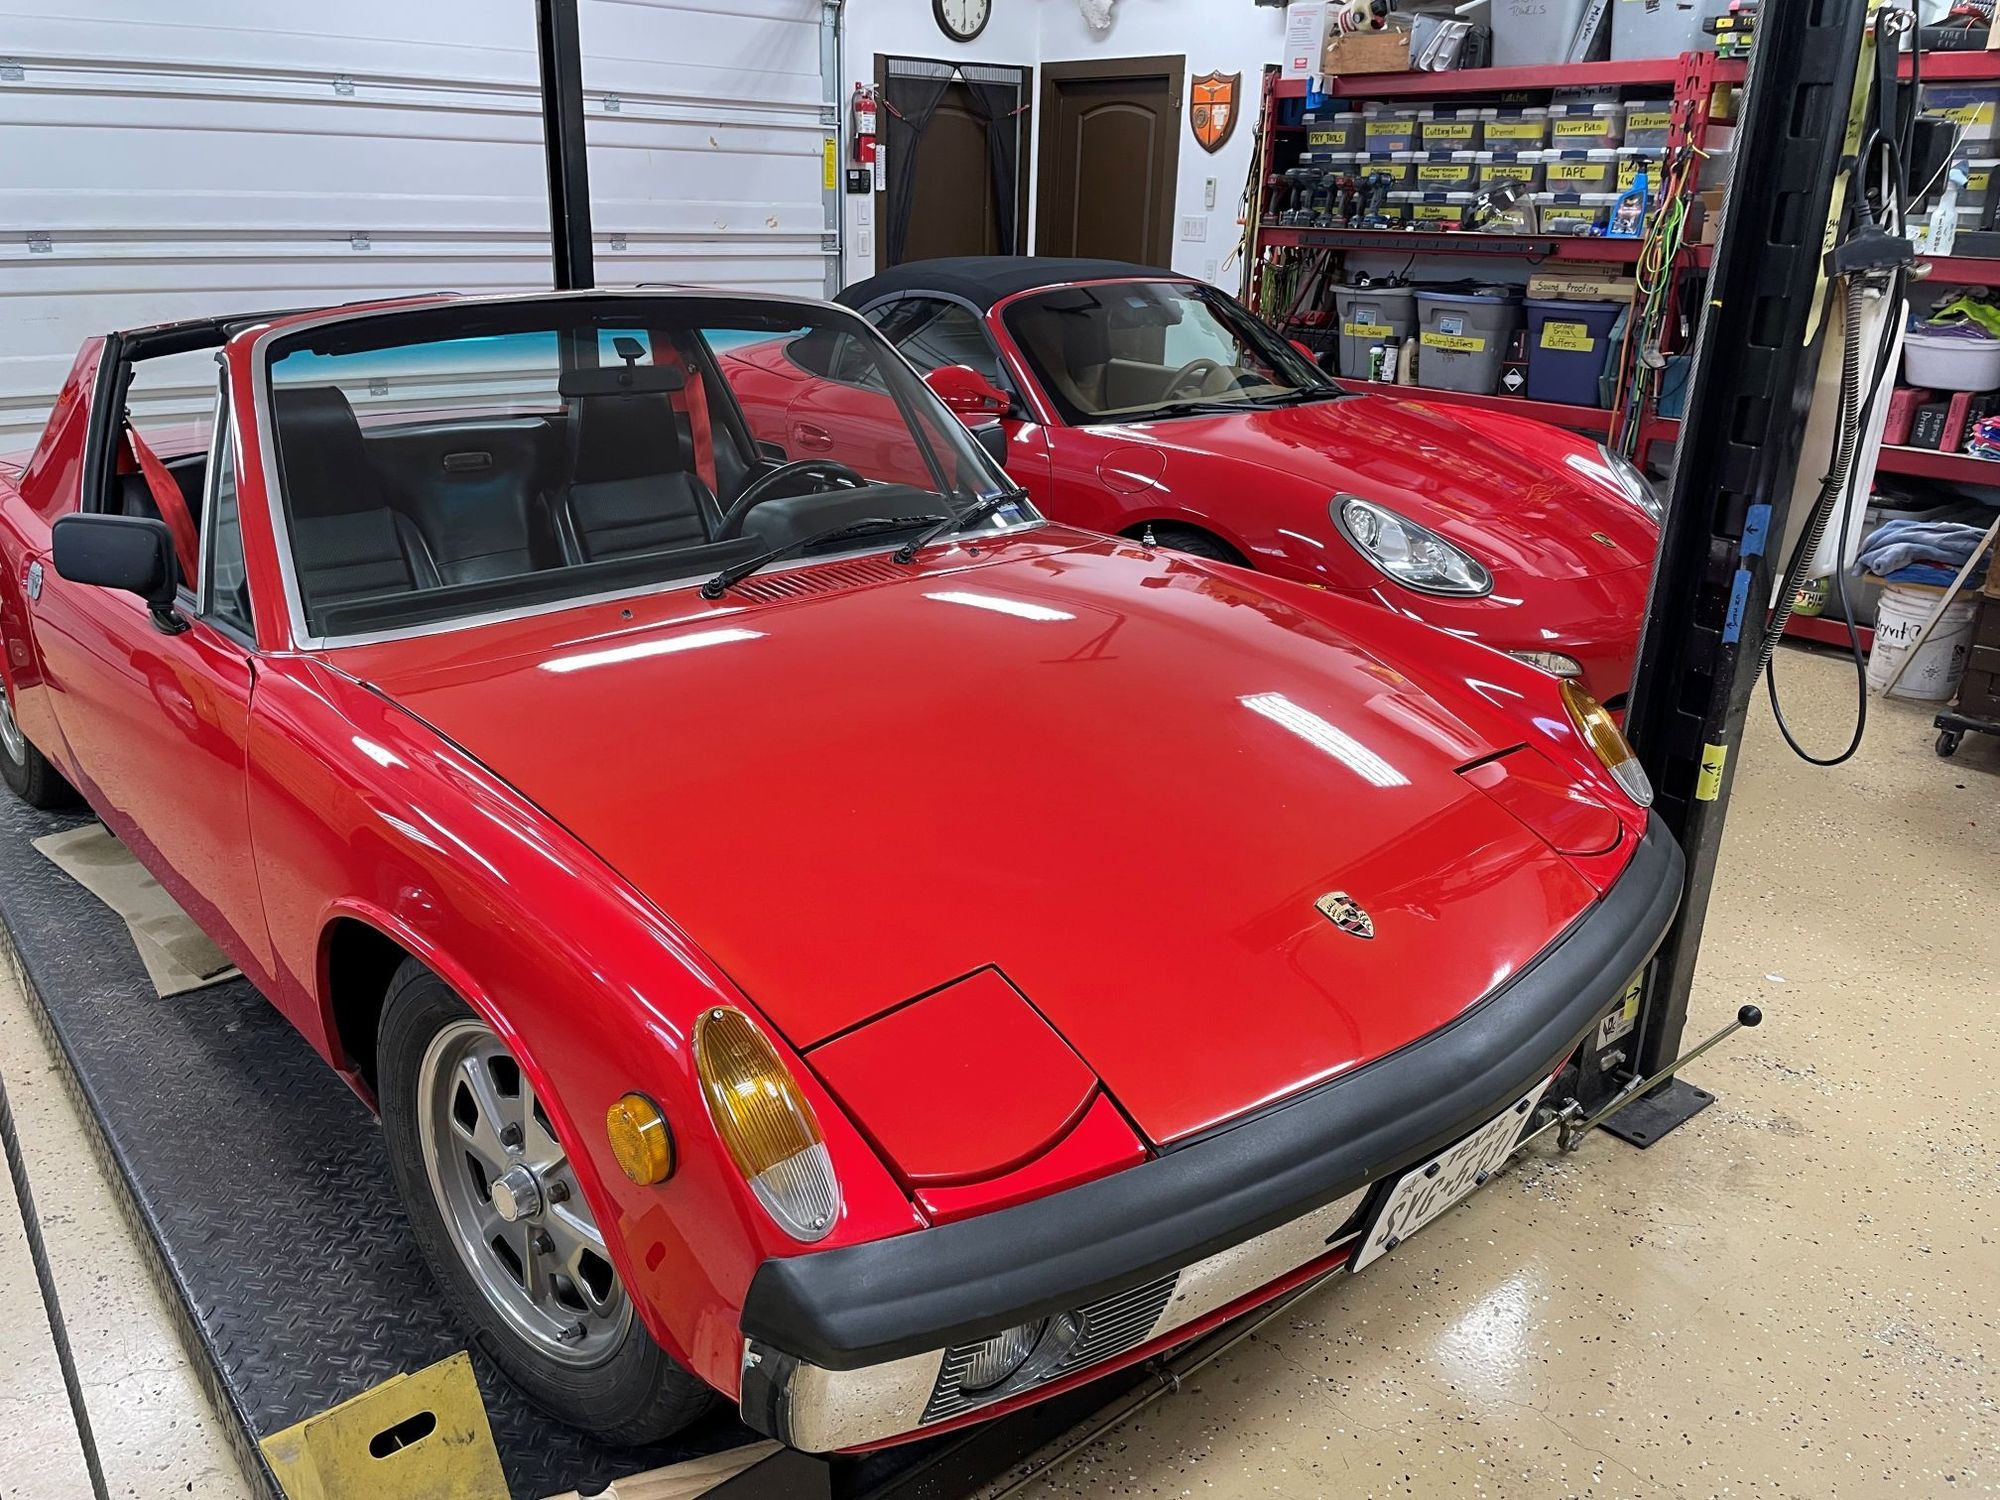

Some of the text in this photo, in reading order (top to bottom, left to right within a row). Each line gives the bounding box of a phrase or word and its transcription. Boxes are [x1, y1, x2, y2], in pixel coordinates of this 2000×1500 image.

[1424, 126, 1469, 137] Cutting Tools
[1490, 126, 1517, 136] Dremel
[1557, 123, 1582, 133] Driver
[1310, 133, 1343, 143] PRY TOOLS
[1560, 167, 1586, 178] TAPE
[1536, 281, 1599, 294] Sound Proofing
[1548, 337, 1577, 349] Buffers
[1446, 1114, 1509, 1168] TEXAS
